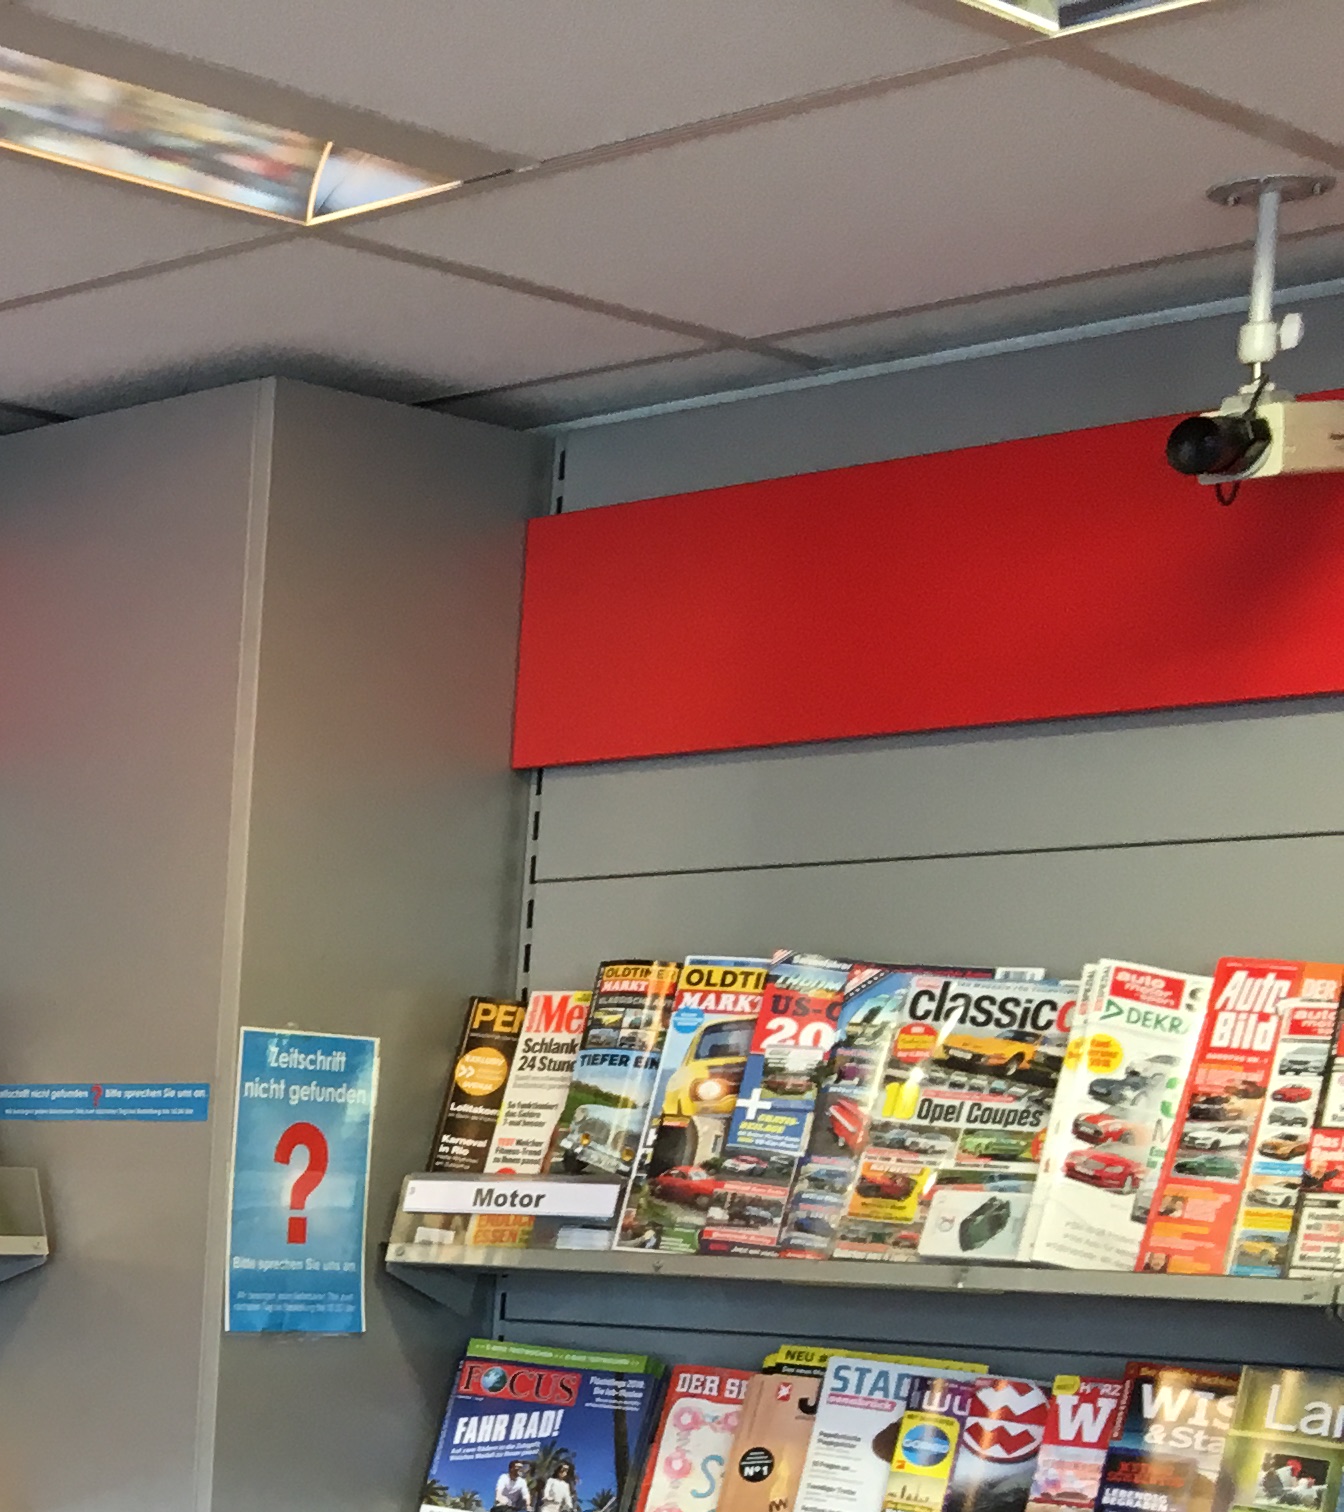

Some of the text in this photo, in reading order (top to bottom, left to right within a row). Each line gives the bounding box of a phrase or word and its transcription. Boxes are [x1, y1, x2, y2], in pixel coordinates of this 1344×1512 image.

[600, 979, 648, 992] MARKT
[1117, 969, 1164, 990] auto
[1217, 971, 1290, 1012] Auto
[1212, 1012, 1277, 1051] Bild
[269, 1046, 346, 1072] Zeitschrift
[244, 1080, 365, 1104] nicht gefunden
[917, 1098, 1043, 1127] Opel Coupés
[442, 1135, 487, 1148] Karneval
[274, 1122, 328, 1244] ?
[472, 1188, 546, 1209] Motor
[233, 1257, 256, 1270] Bitte
[259, 1258, 303, 1272] sprechen
[306, 1257, 319, 1270] Sie
[323, 1258, 340, 1271] uns
[784, 1350, 815, 1365] NEU
[676, 1374, 720, 1398] DER
[453, 1409, 566, 1444] FAHR RAD!
